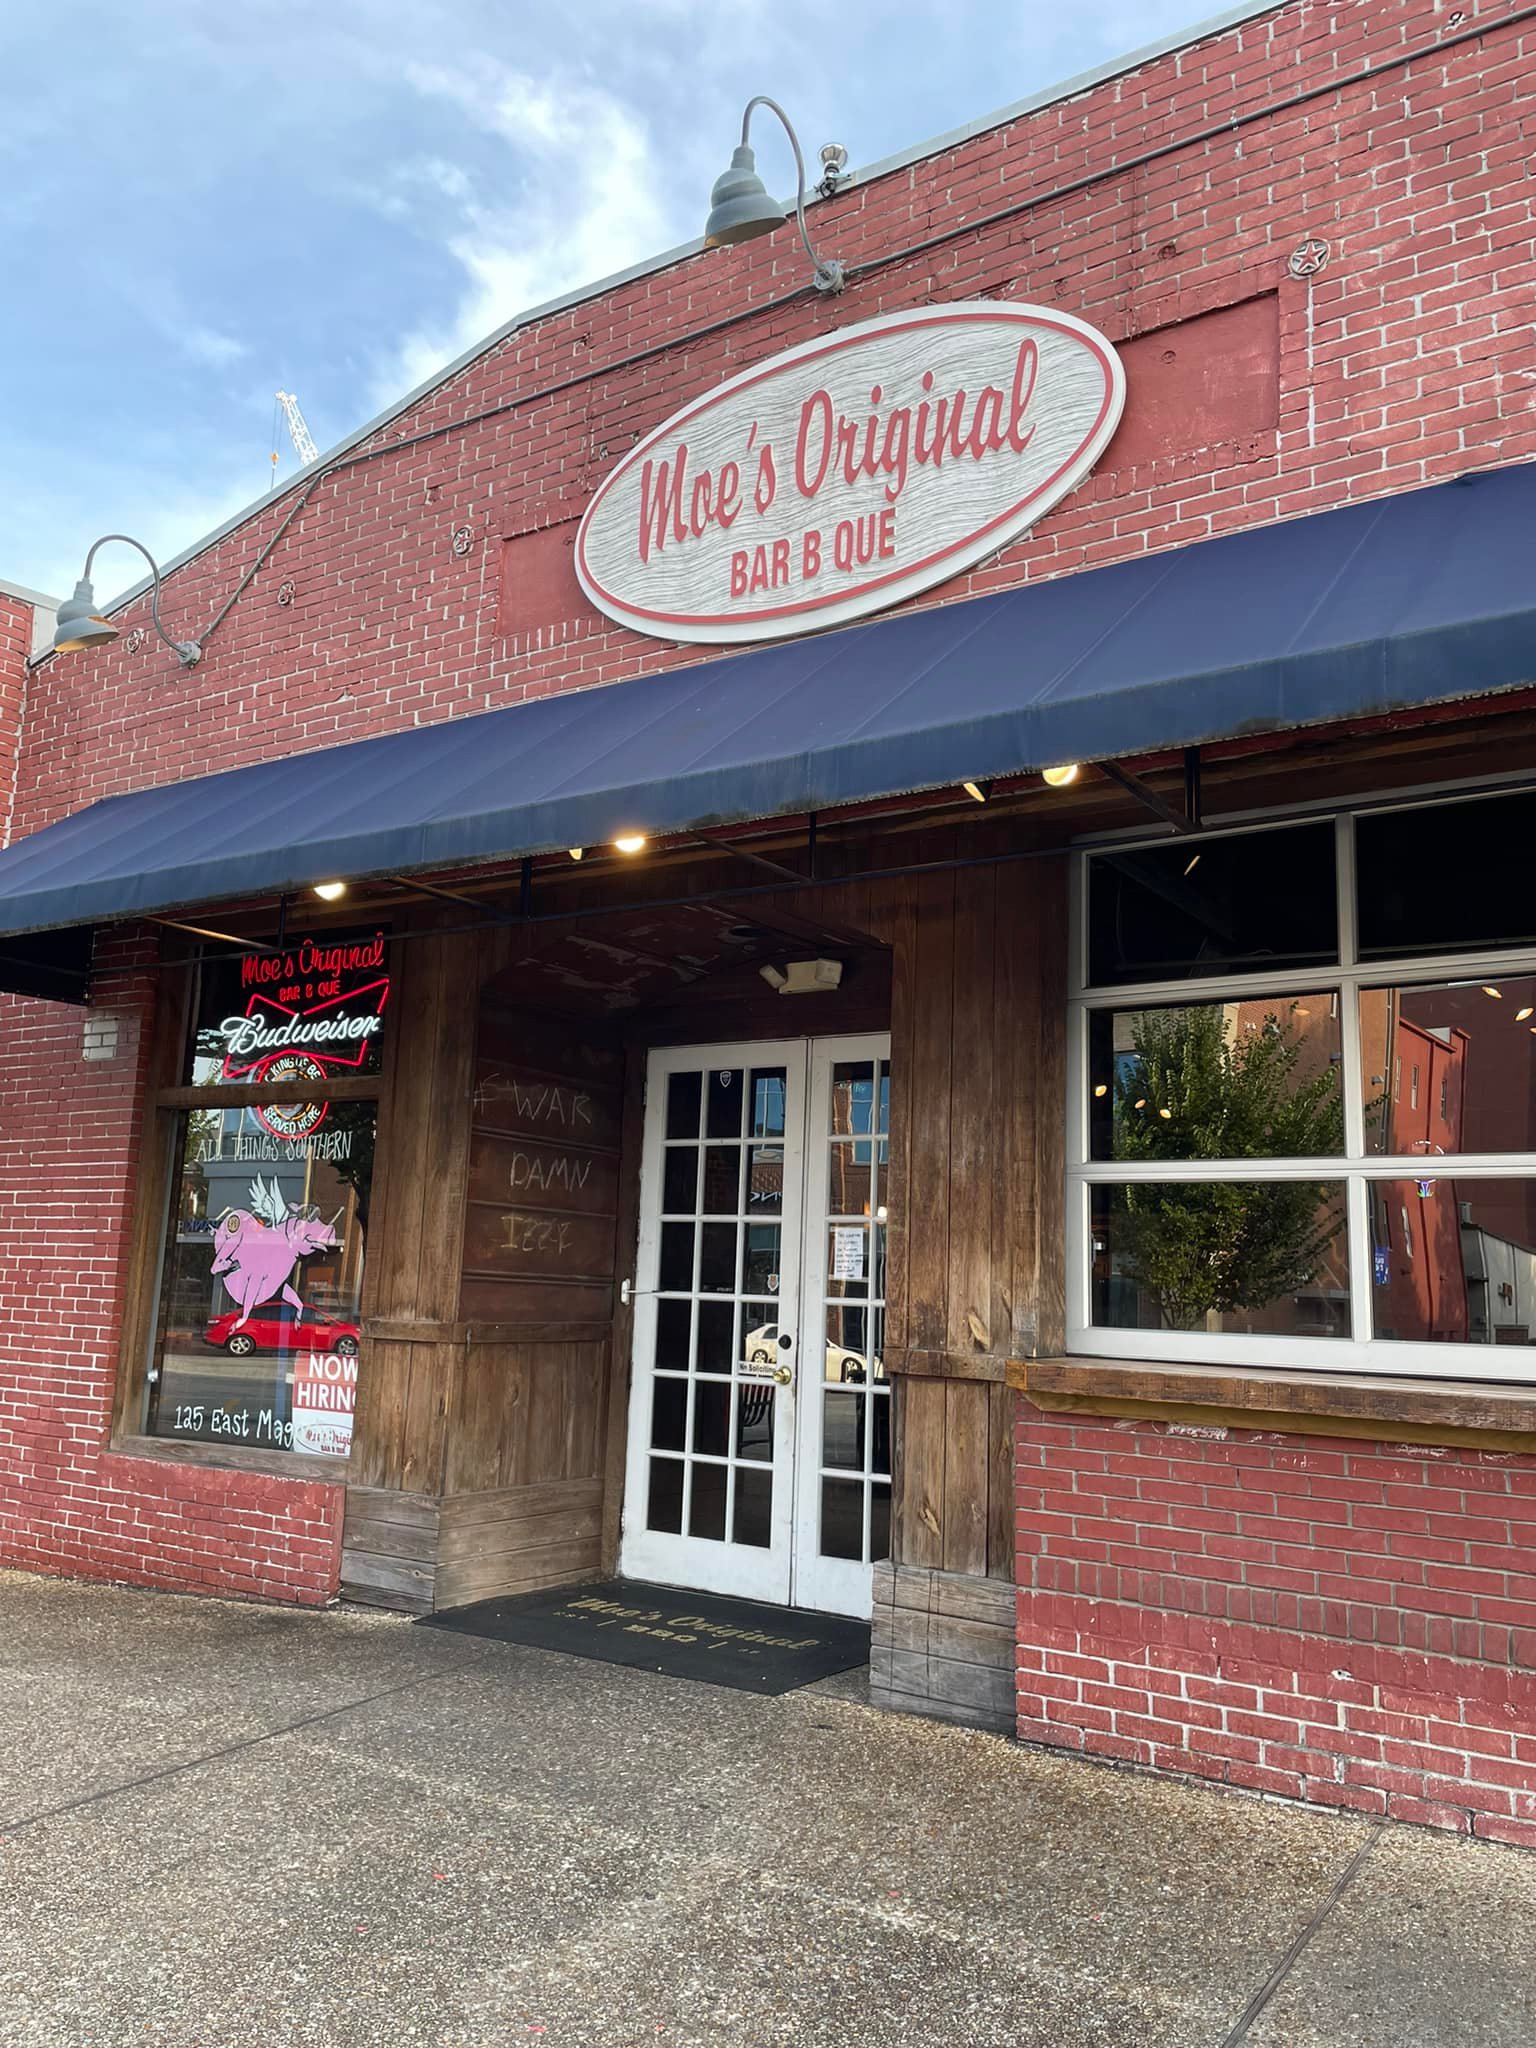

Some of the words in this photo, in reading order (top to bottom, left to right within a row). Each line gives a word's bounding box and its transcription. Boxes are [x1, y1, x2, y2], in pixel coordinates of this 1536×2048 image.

[638, 421, 777, 565] Moe's
[796, 338, 1039, 502] Original
[730, 537, 790, 599] BAR
[802, 529, 823, 580] B
[834, 506, 897, 574] QUE
[241, 951, 294, 988] Moe's
[299, 931, 385, 978] Original
[279, 985, 301, 1002] BAR
[317, 979, 341, 997] QUE
[220, 1010, 382, 1053] Budweiser
[263, 1107, 296, 1134] SERVED
[297, 1105, 321, 1132] HERE
[512, 1079, 592, 1126] WAR
[195, 1138, 222, 1162] ALL
[232, 1134, 280, 1161] THINGS
[285, 1130, 352, 1161] SOUTHERN
[510, 1152, 593, 1192] DAMN
[308, 1353, 359, 1382] NOW
[174, 1405, 205, 1431] 125
[211, 1407, 249, 1437] East
[666, 1616, 819, 1650] Original
